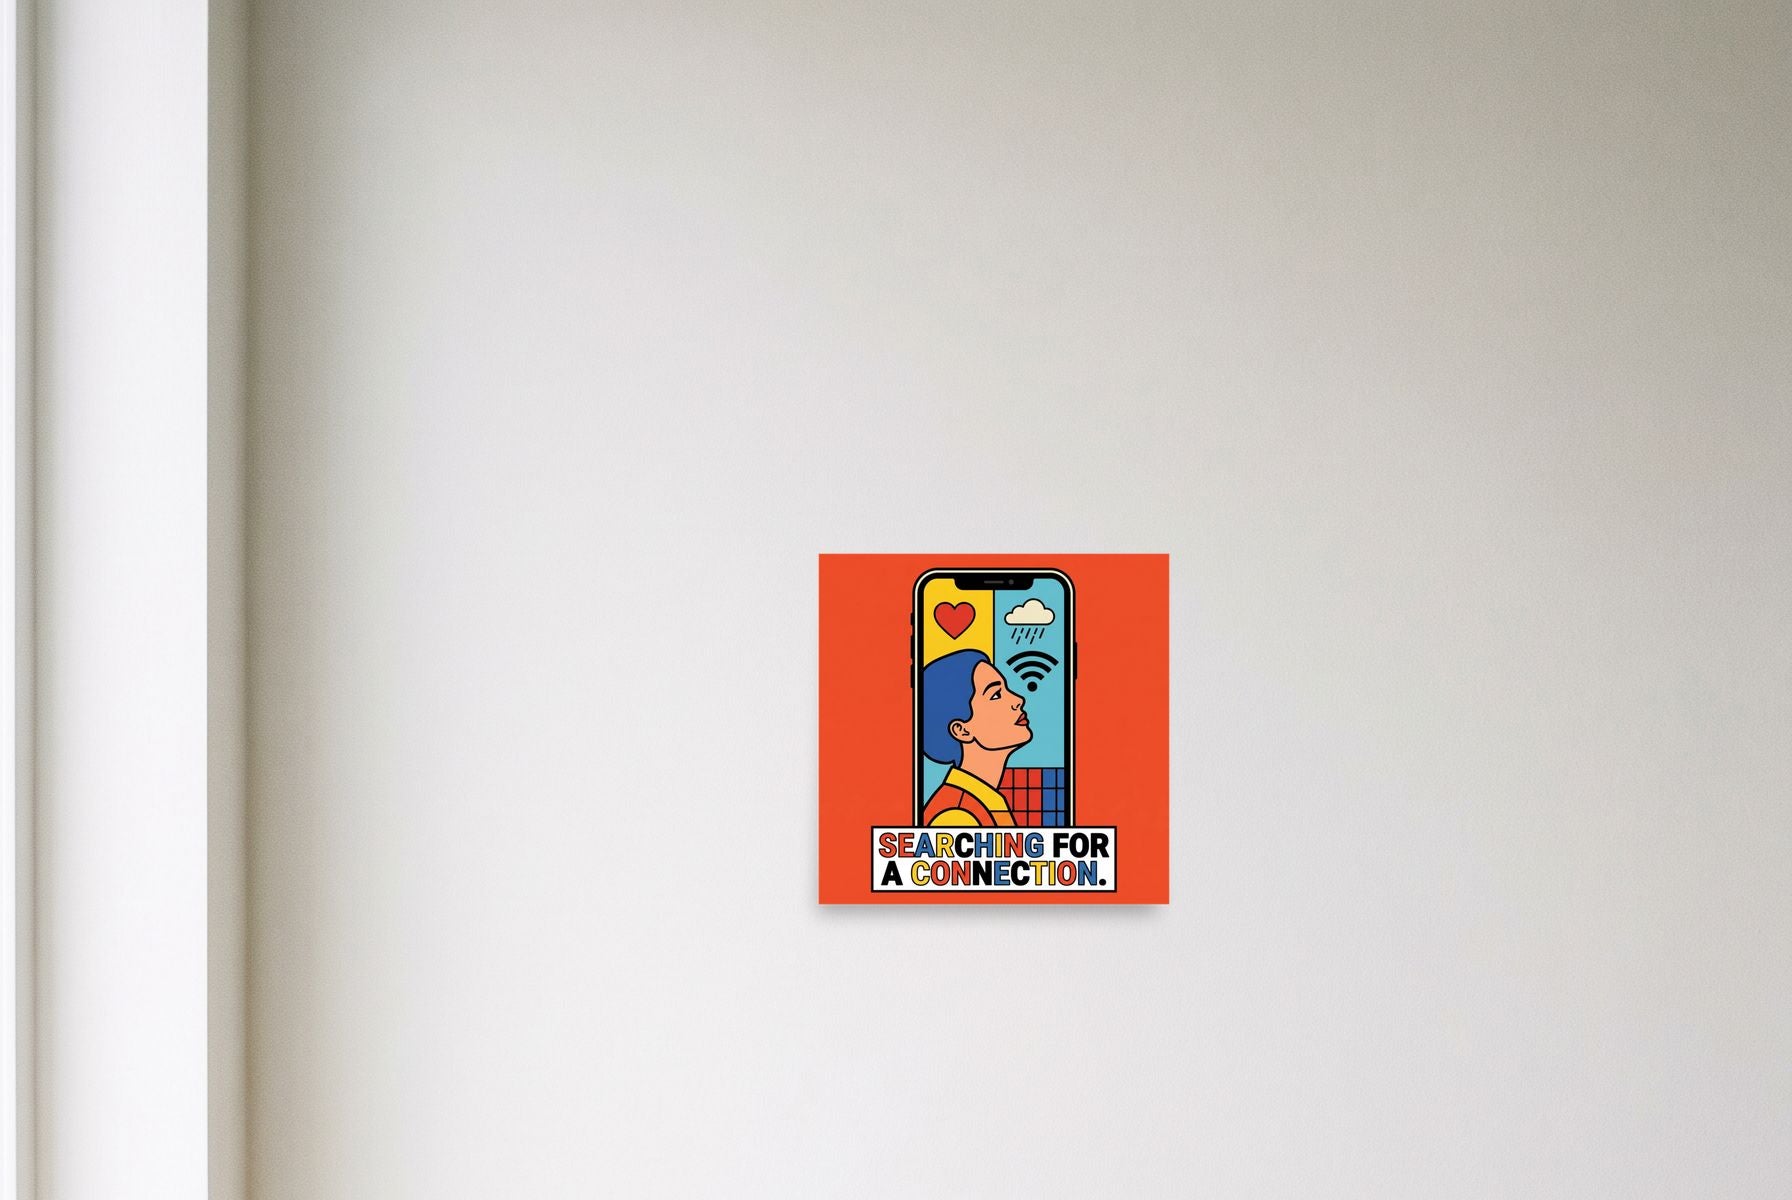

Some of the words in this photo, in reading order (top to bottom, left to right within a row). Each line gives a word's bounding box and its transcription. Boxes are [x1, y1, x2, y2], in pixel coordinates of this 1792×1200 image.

[878, 832, 1045, 859] SEARCHING
[1053, 832, 1110, 859] FOR
[881, 860, 904, 886] A
[910, 860, 1107, 887] CONNECTION.
